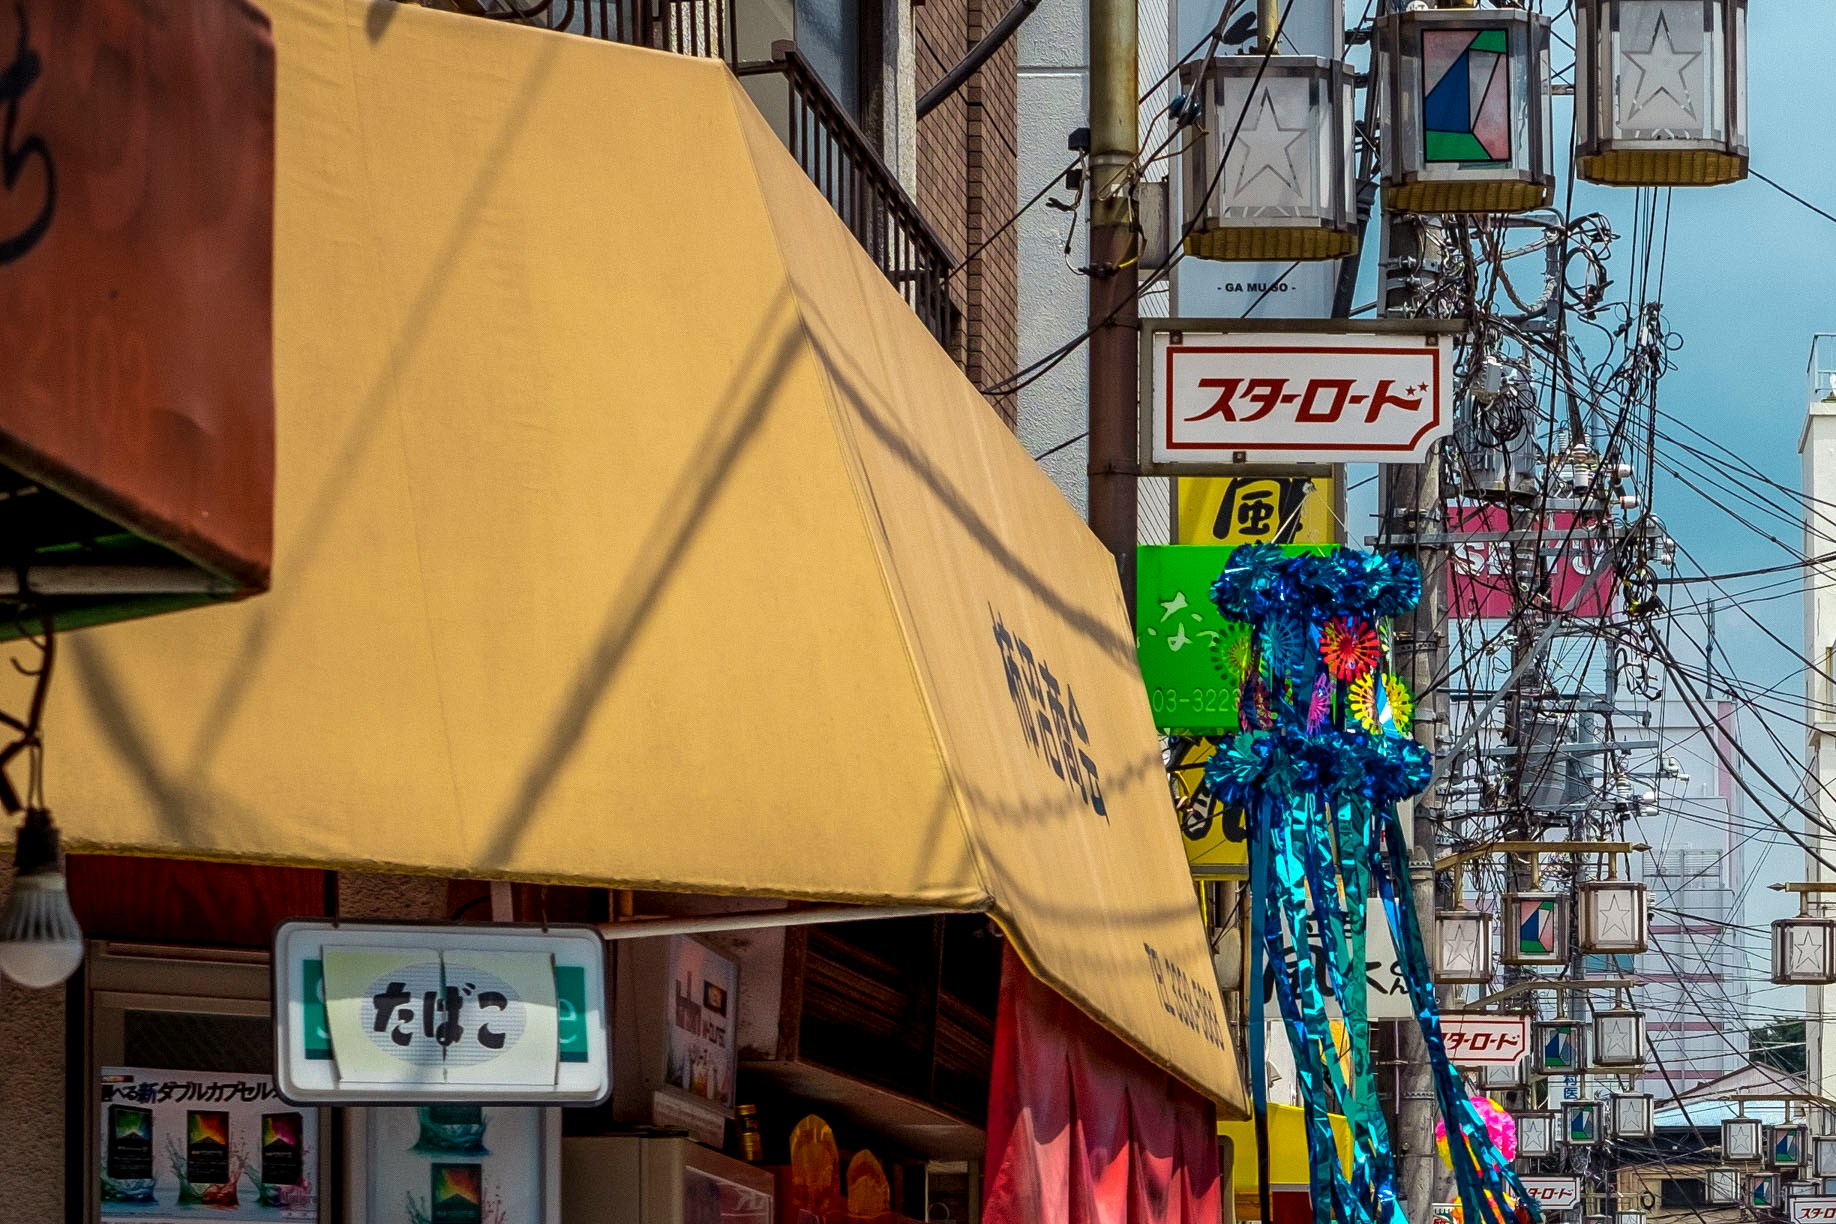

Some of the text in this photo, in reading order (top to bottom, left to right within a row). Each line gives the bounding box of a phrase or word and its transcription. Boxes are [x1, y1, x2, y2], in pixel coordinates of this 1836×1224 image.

[1225, 283, 1243, 292] GA
[1247, 283, 1267, 292] MU
[1184, 377, 1429, 424] スターロード
[372, 981, 509, 1049] たばこ
[1443, 1032, 1521, 1051] ターロード
[1522, 1187, 1574, 1200] ターロード
